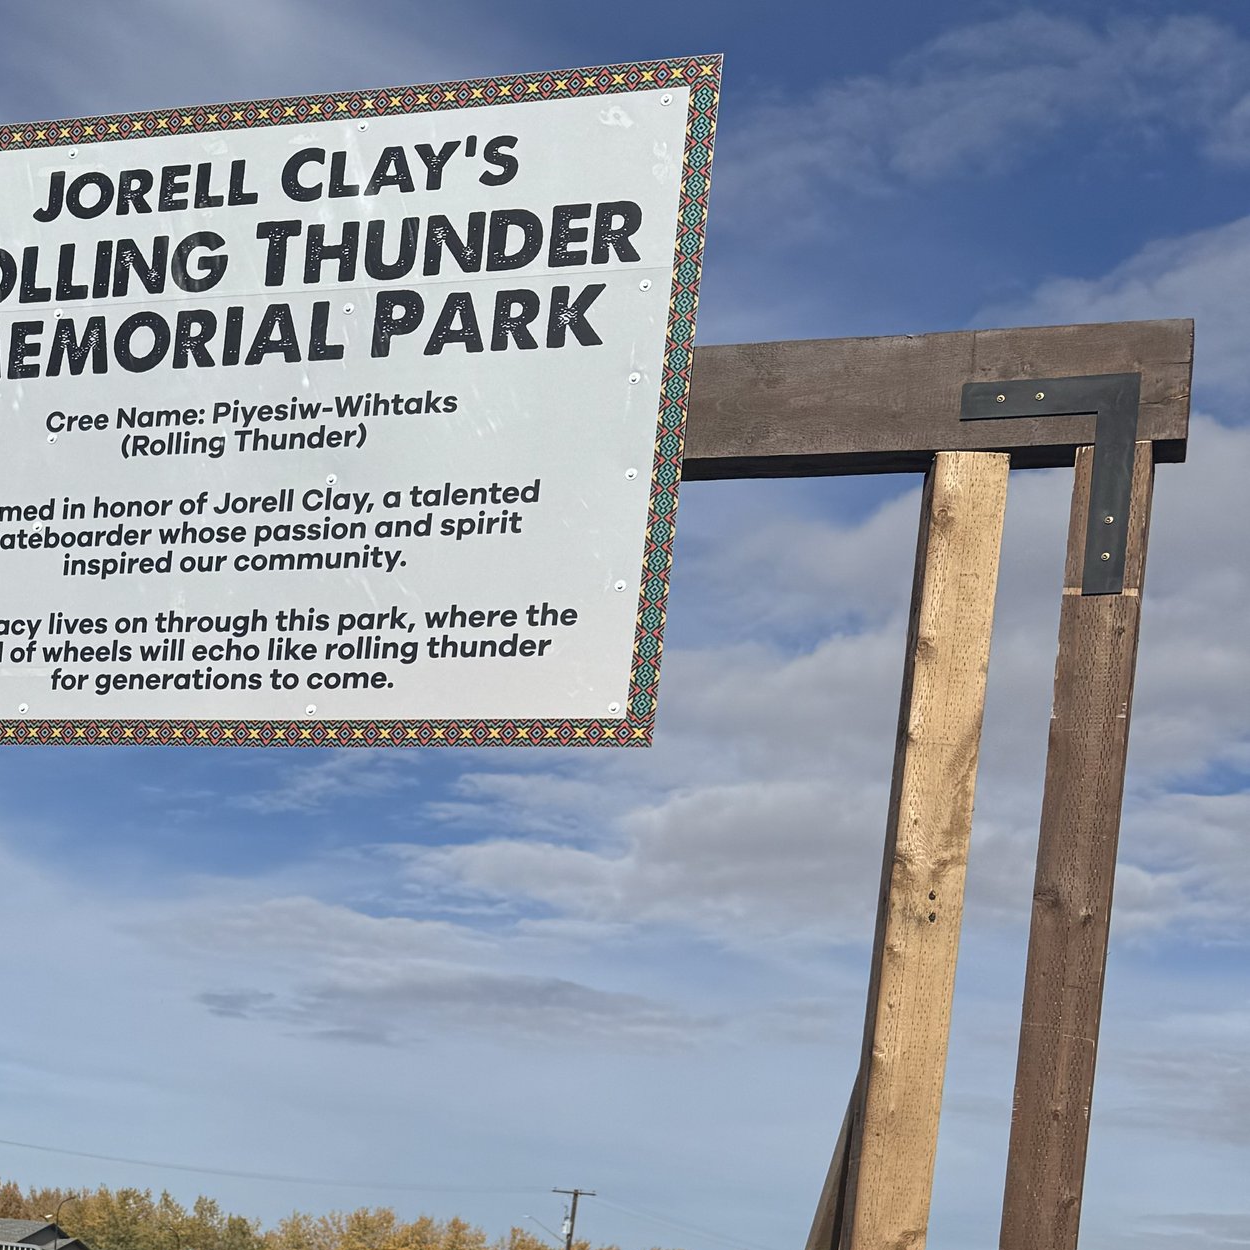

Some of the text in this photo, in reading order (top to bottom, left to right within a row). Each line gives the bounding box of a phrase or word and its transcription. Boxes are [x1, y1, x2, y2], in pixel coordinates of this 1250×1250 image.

[32, 134, 519, 223] JORELL CLAY'S
[256, 200, 643, 287] THUNDER
[370, 283, 607, 359] PARK
[45, 390, 458, 433] Cree Name: Piyesiw-Wihtaks
[121, 422, 367, 459] (Rolling Thunder)
[62, 496, 86, 520] in
[93, 496, 174, 519] honor
[179, 491, 209, 516] of
[213, 488, 295, 515] Jorell
[302, 487, 375, 516] Clay,
[382, 490, 402, 509] a
[409, 478, 541, 508] talented
[158, 521, 247, 545] whose
[253, 517, 367, 547] passion
[374, 512, 433, 539] and
[439, 509, 523, 541] spirit
[63, 544, 407, 580] inspired our community.
[48, 611, 108, 635] lives
[114, 616, 148, 634] on
[154, 608, 268, 636] through
[275, 607, 330, 632] this
[337, 605, 416, 636] park,
[424, 604, 518, 629] where
[525, 602, 578, 627] the
[9, 642, 38, 663] of
[42, 639, 132, 663] wheels
[139, 638, 185, 662] will
[191, 638, 260, 662] echo
[267, 636, 318, 661] like
[325, 635, 419, 665] rolling
[426, 632, 552, 659] thunder
[50, 667, 394, 695] for generations to come.
